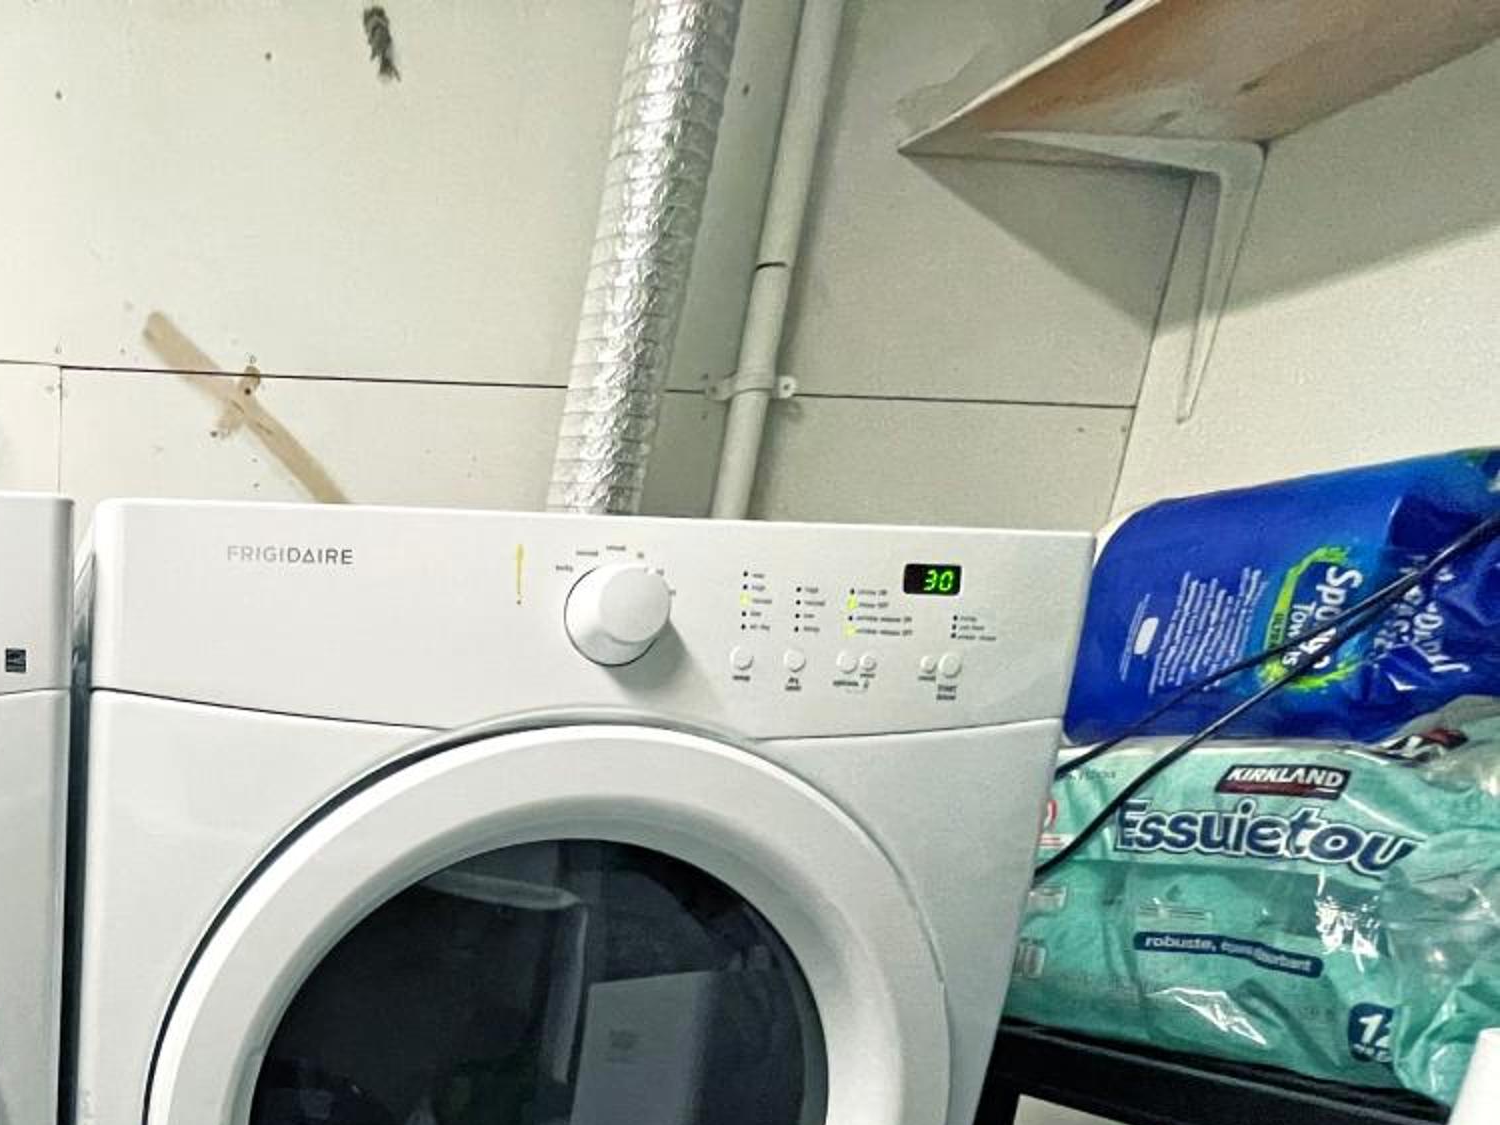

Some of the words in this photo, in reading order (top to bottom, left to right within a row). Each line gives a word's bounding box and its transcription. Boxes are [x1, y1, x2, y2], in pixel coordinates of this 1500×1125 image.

[226, 545, 354, 566] FRIGIDAIRE
[923, 569, 954, 592] 30
[1226, 766, 1345, 788] KIRKLAND
